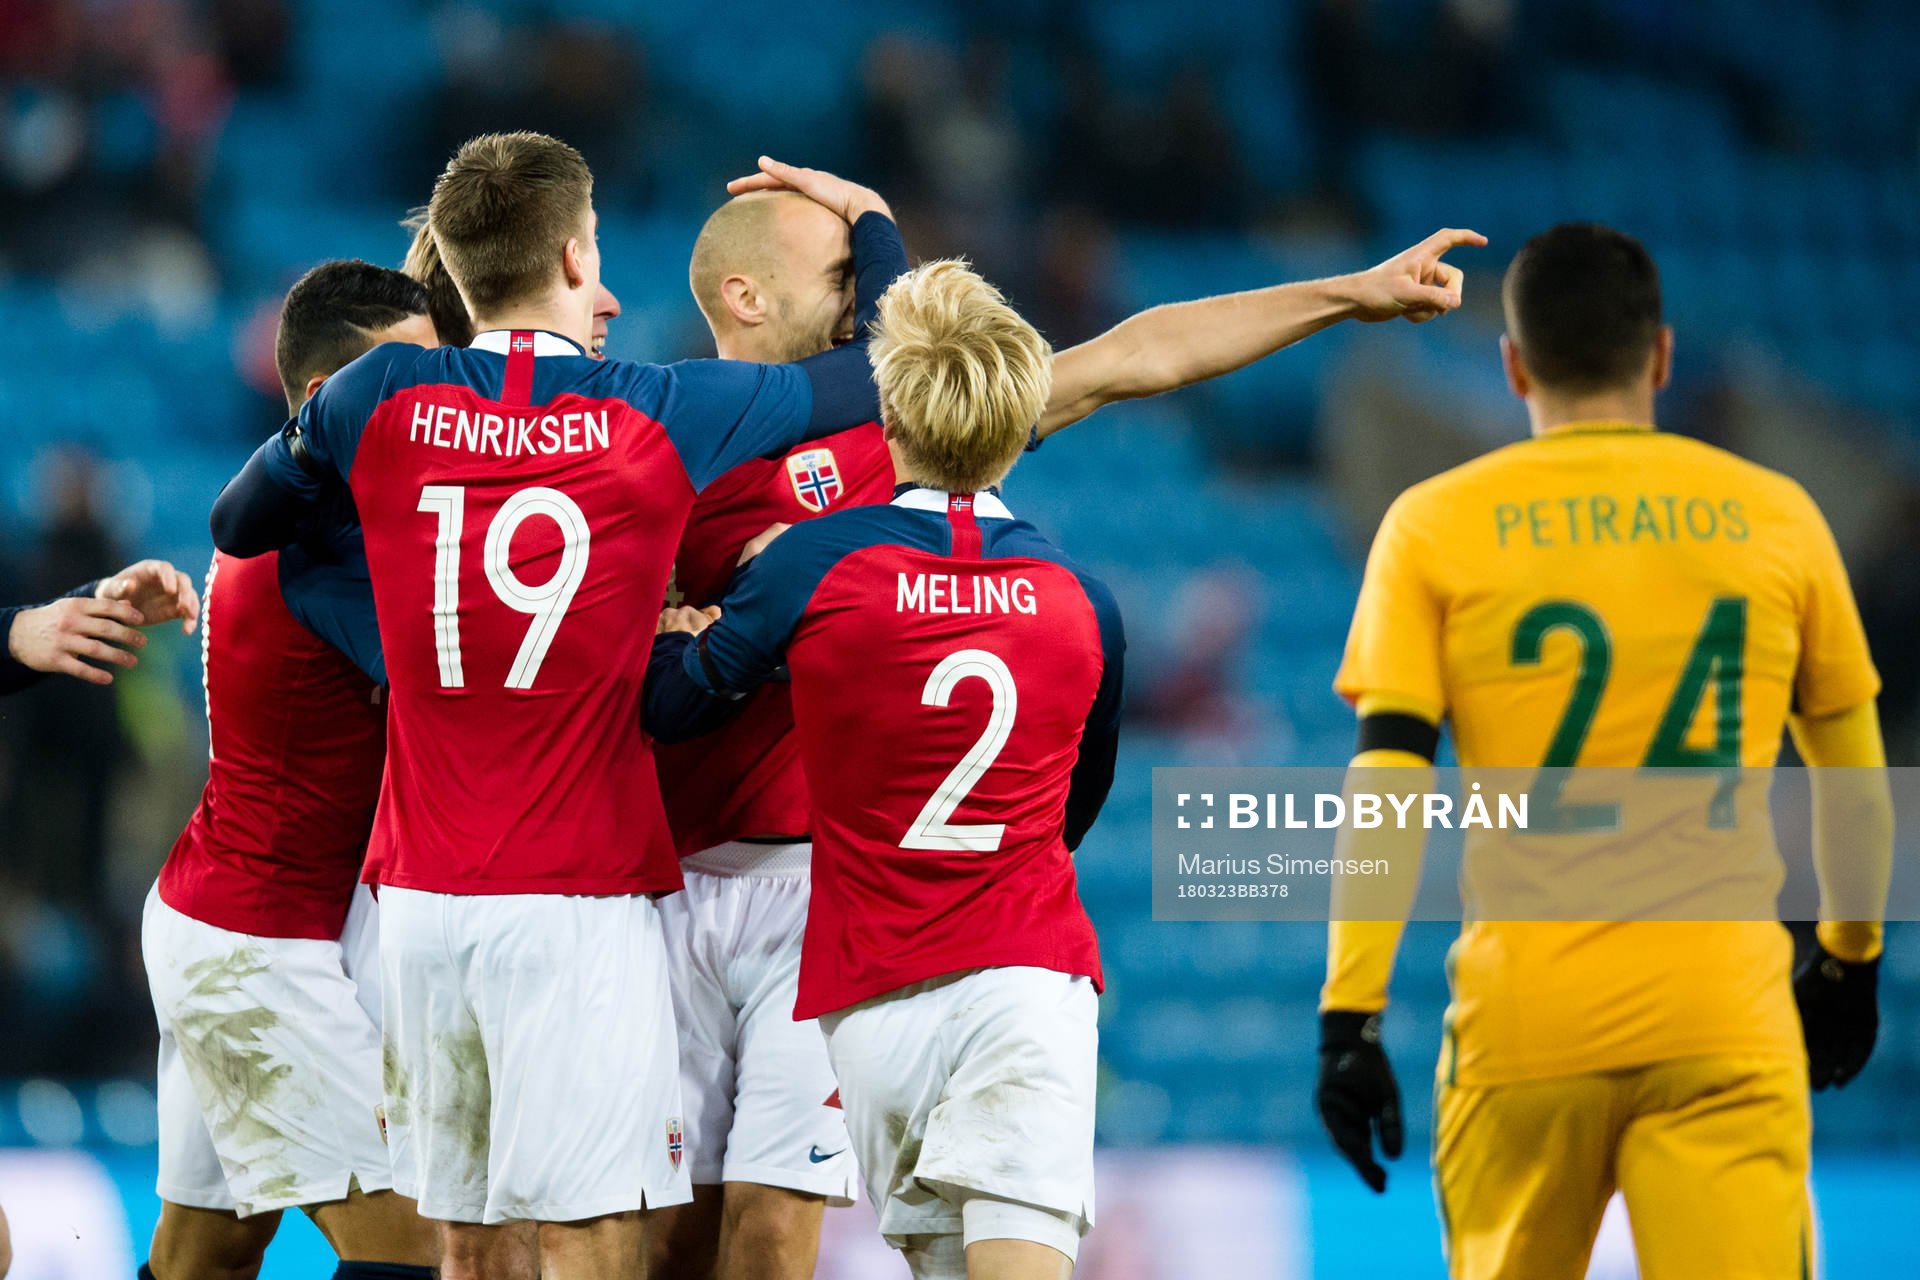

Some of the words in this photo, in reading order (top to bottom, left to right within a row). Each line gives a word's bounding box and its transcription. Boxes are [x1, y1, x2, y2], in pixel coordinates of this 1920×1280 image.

[410, 402, 609, 456] HENRIKSEN
[1494, 495, 1749, 547] PETRATOS
[417, 485, 591, 688] 19
[896, 573, 1037, 615] MELING
[898, 649, 1017, 852] 2
[1509, 596, 1748, 834] 24
